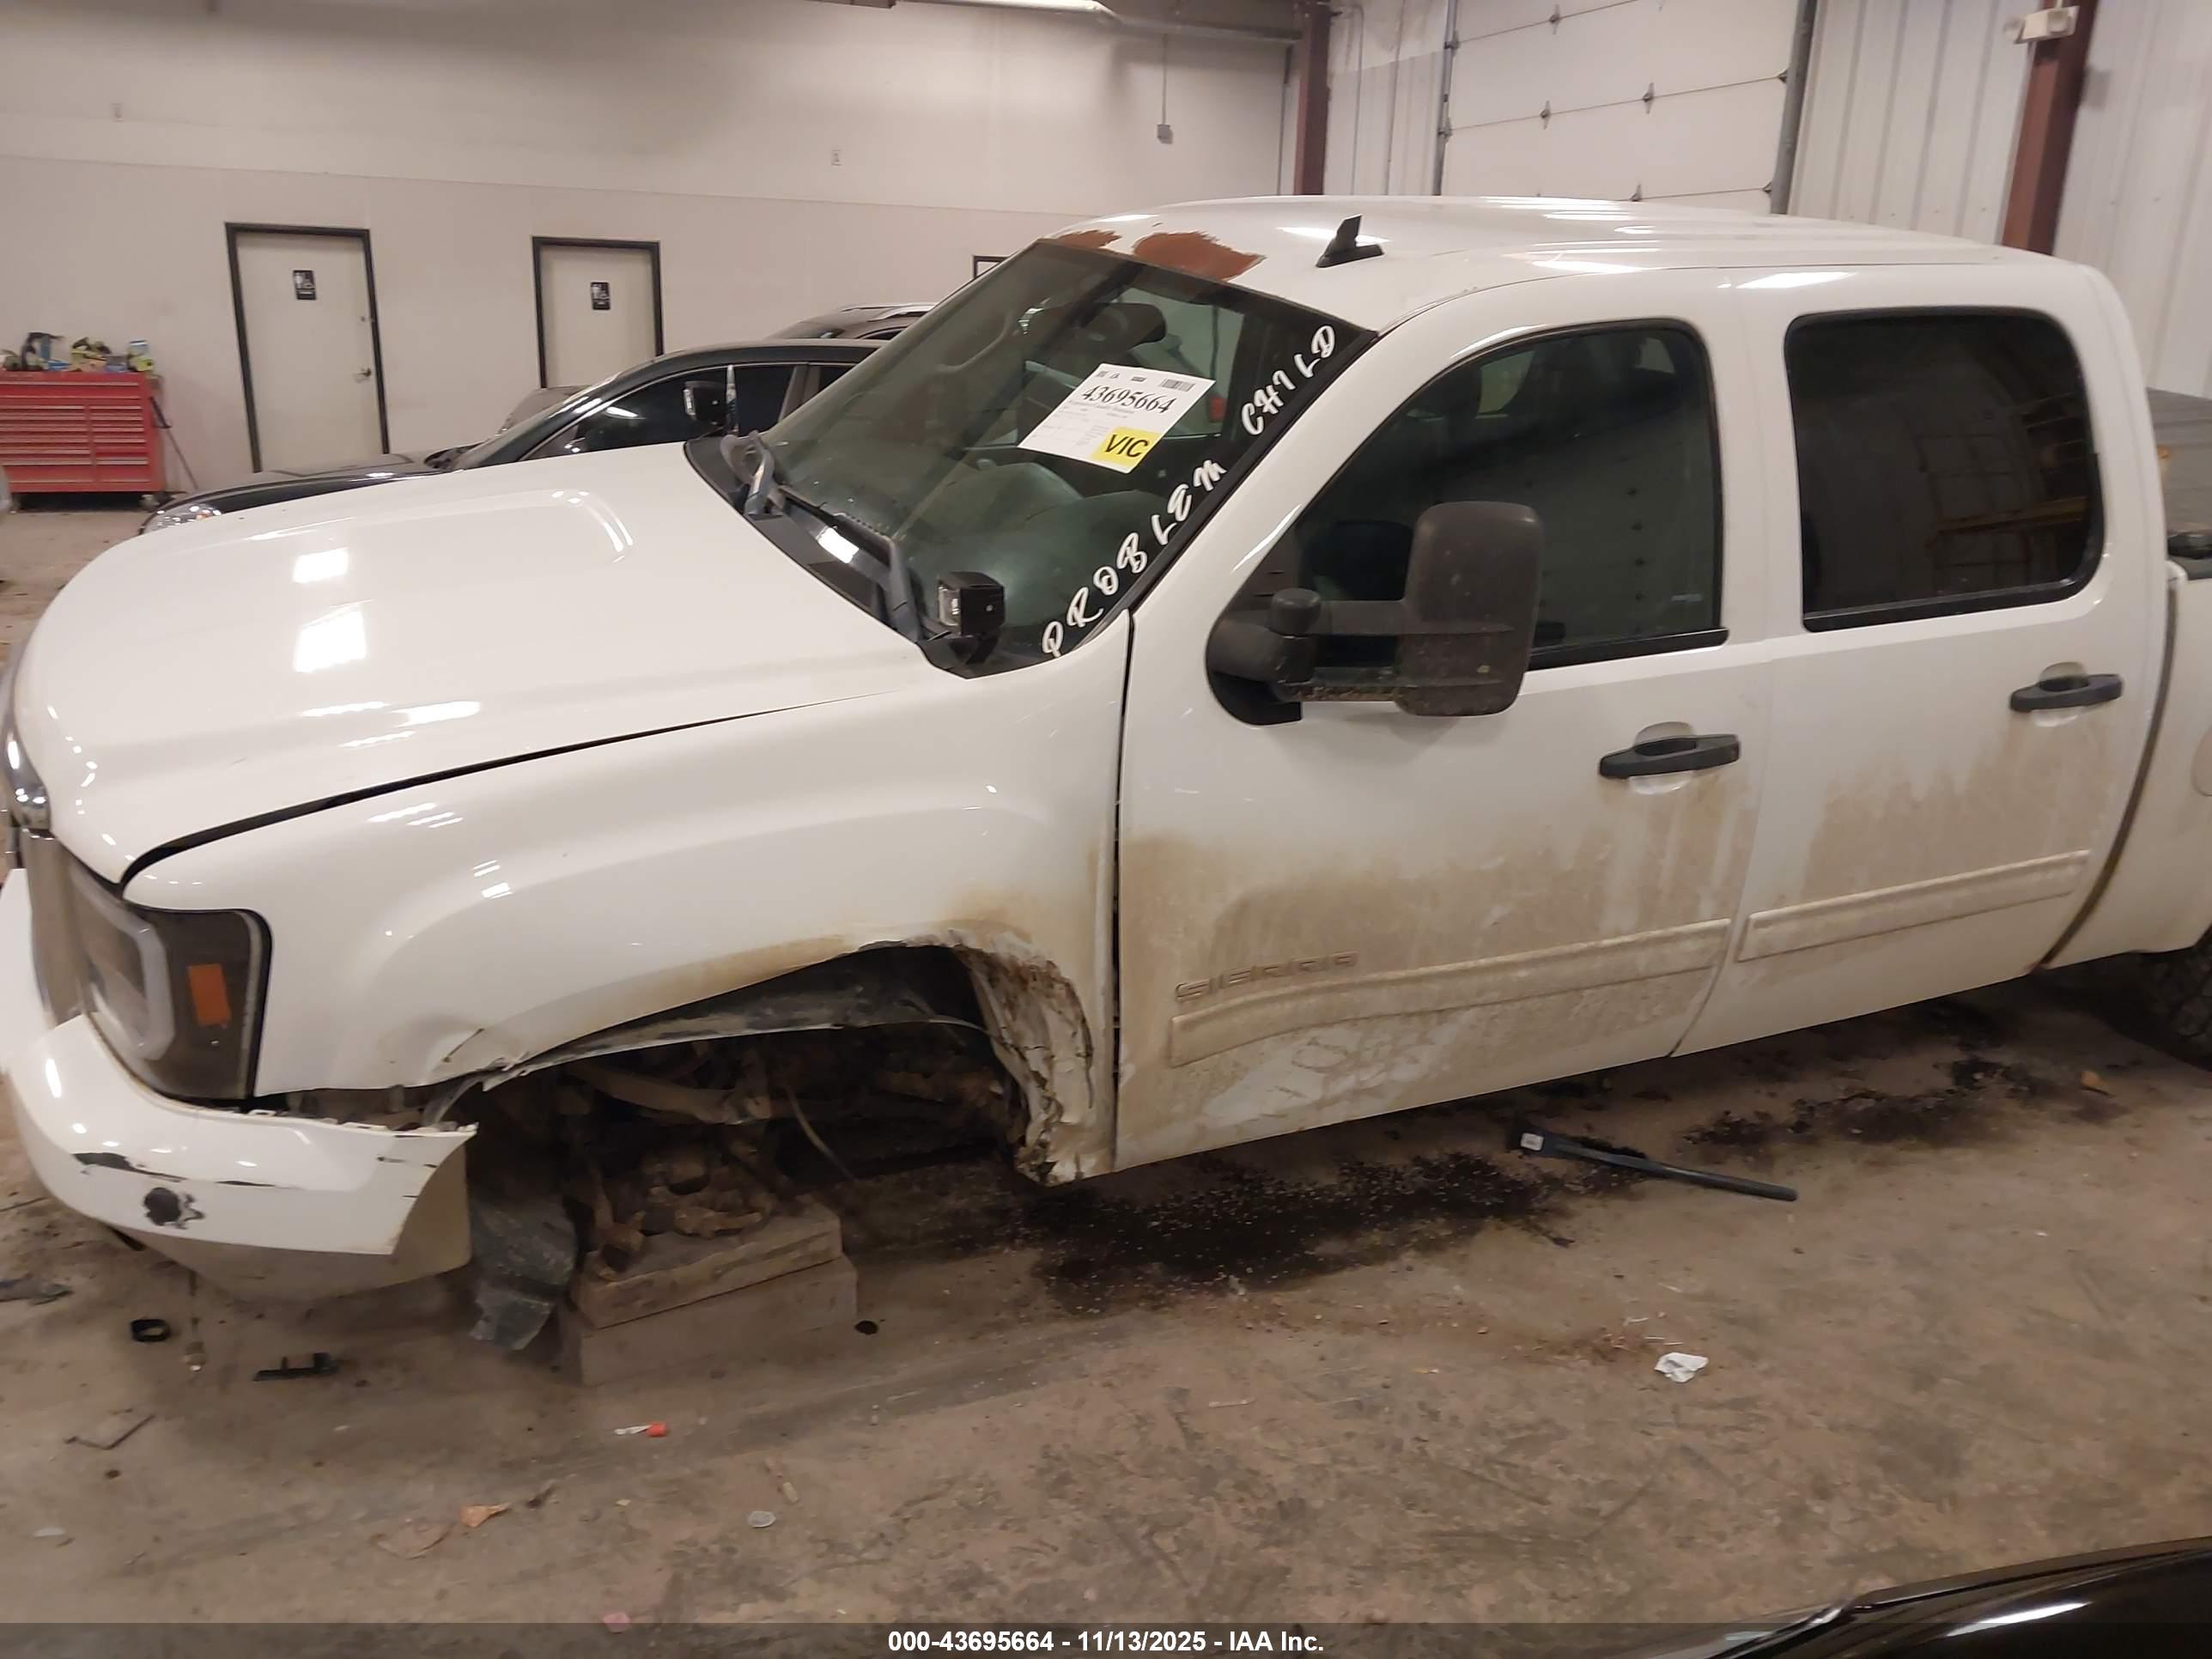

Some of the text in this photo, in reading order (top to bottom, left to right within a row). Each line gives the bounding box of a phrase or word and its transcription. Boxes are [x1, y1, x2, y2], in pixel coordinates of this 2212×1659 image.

[1082, 385, 1177, 414] 43695664
[1104, 434, 1149, 459] VIC
[1042, 459, 1228, 658] PROBLEM
[1240, 325, 1336, 436] CHILD
